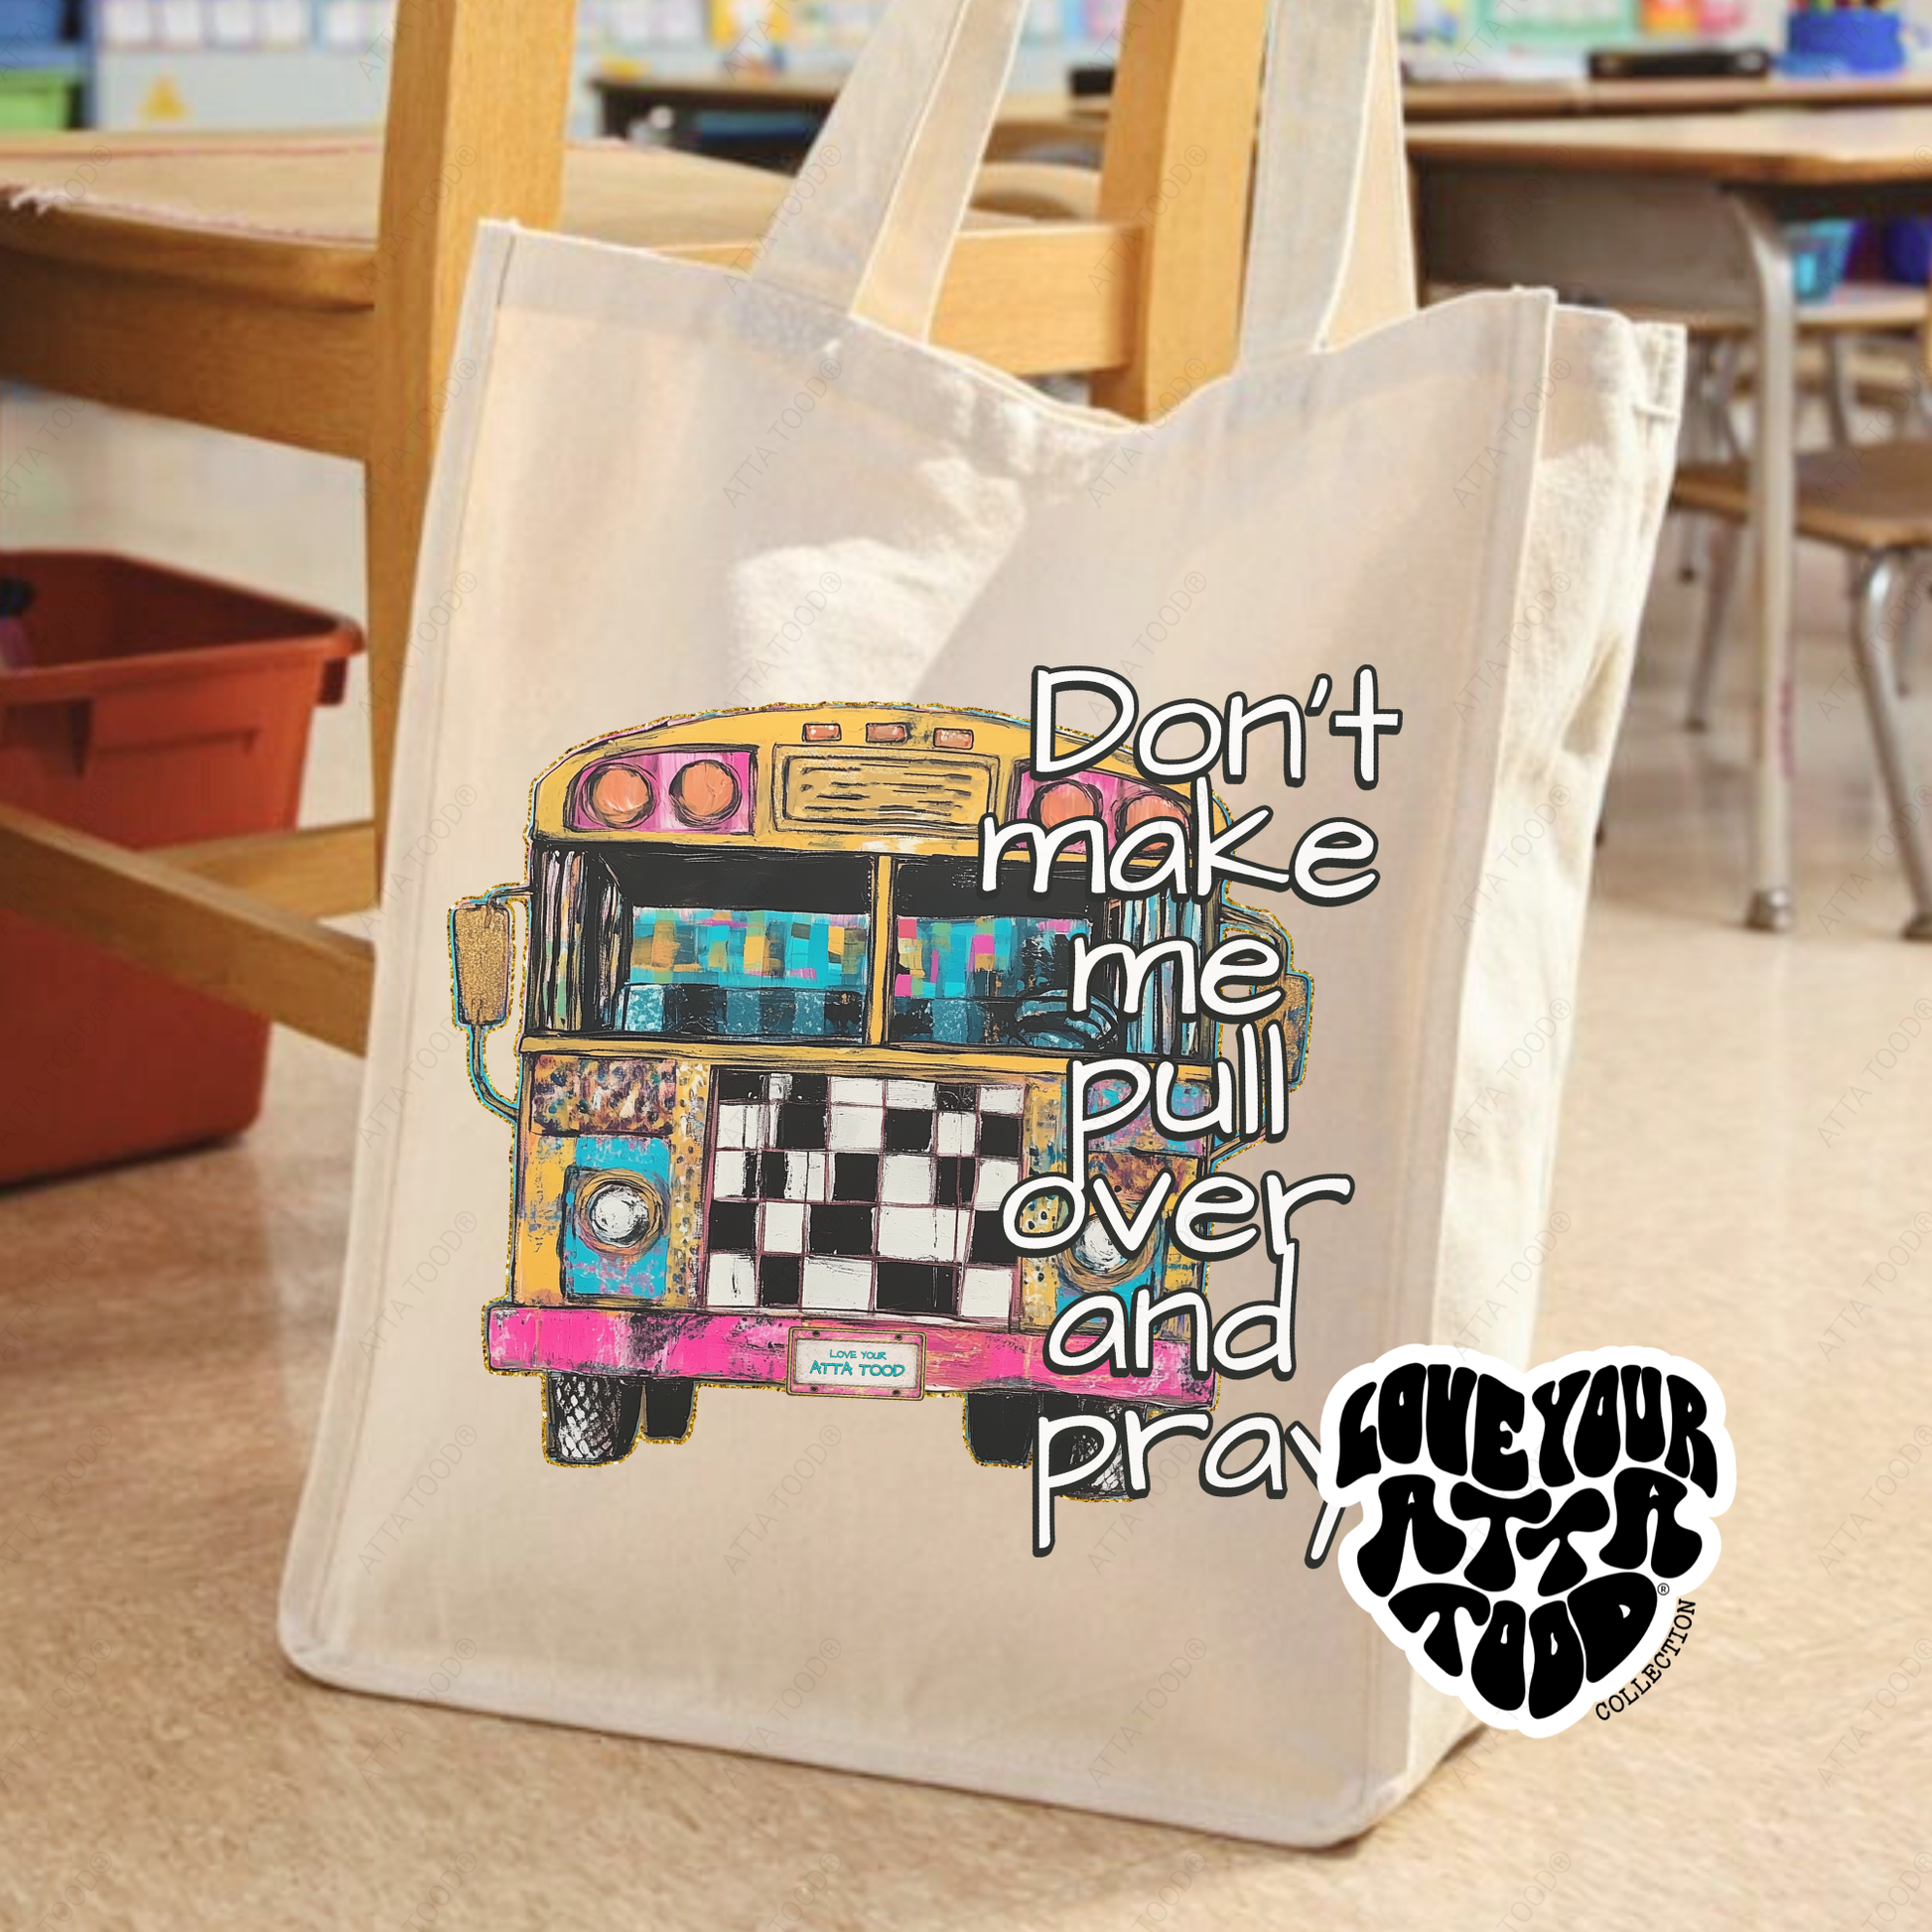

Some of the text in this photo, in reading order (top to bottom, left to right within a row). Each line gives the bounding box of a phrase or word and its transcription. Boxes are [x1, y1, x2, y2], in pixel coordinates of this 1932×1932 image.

[1030, 664, 1402, 790] Don't
[978, 772, 1381, 906] make
[1066, 932, 1286, 1024] me
[1066, 1020, 1289, 1189] pull
[1001, 1170, 1355, 1263] over
[829, 1349, 887, 1360] LOVE YOUR
[1043, 1238, 1300, 1381] and
[809, 1360, 905, 1377] ATTA TOOD
